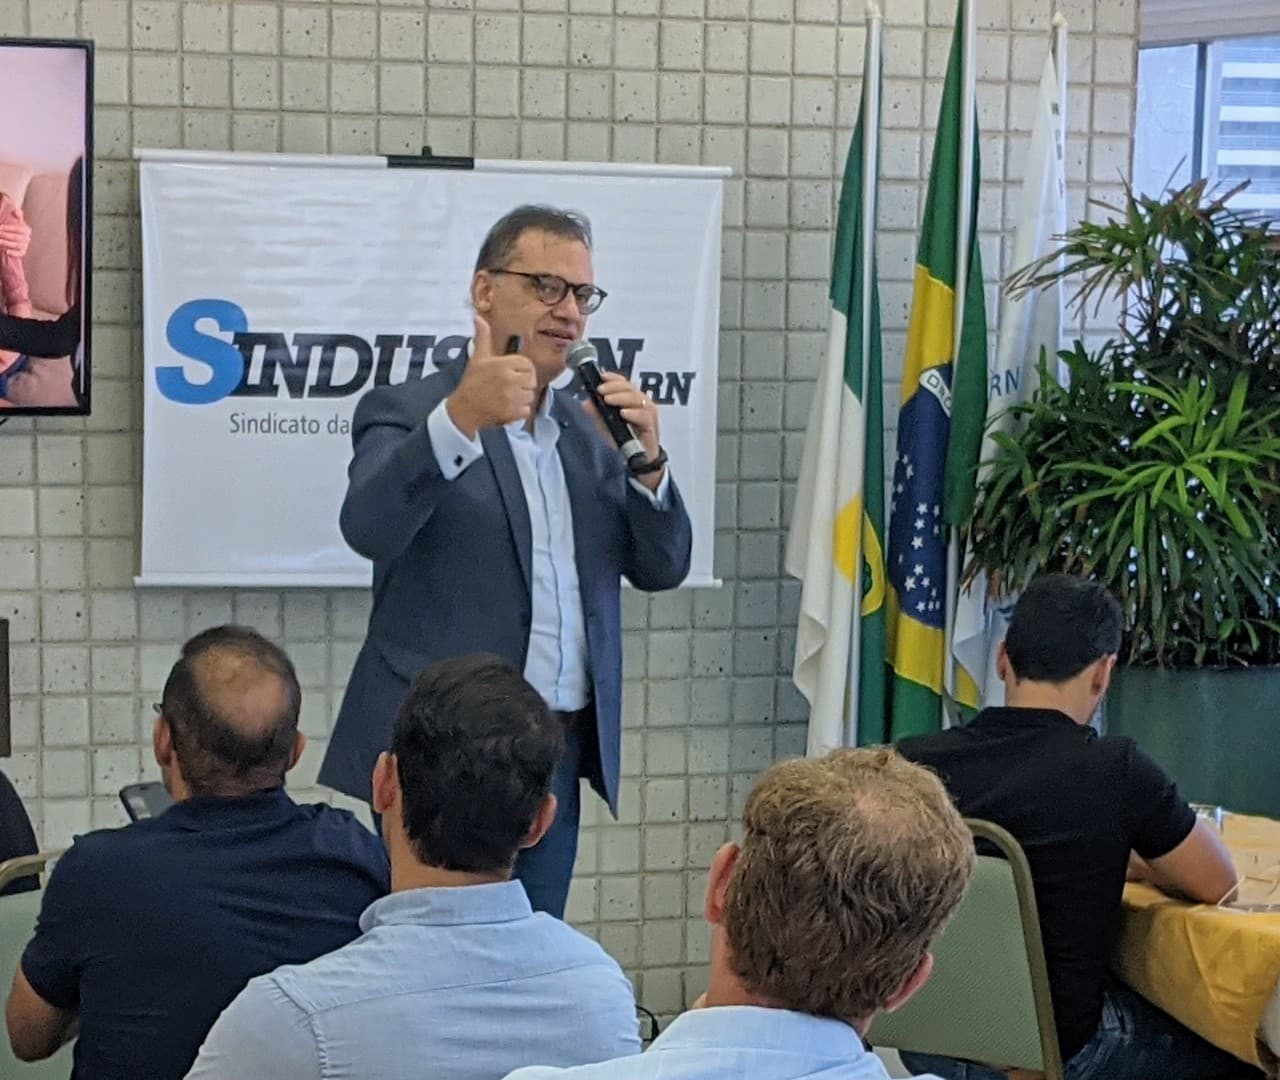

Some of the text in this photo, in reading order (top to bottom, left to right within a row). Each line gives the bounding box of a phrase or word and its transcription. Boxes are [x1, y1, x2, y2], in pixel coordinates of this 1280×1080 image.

[155, 298, 645, 406] SINDUN
[229, 412, 350, 435] Sindicato da
